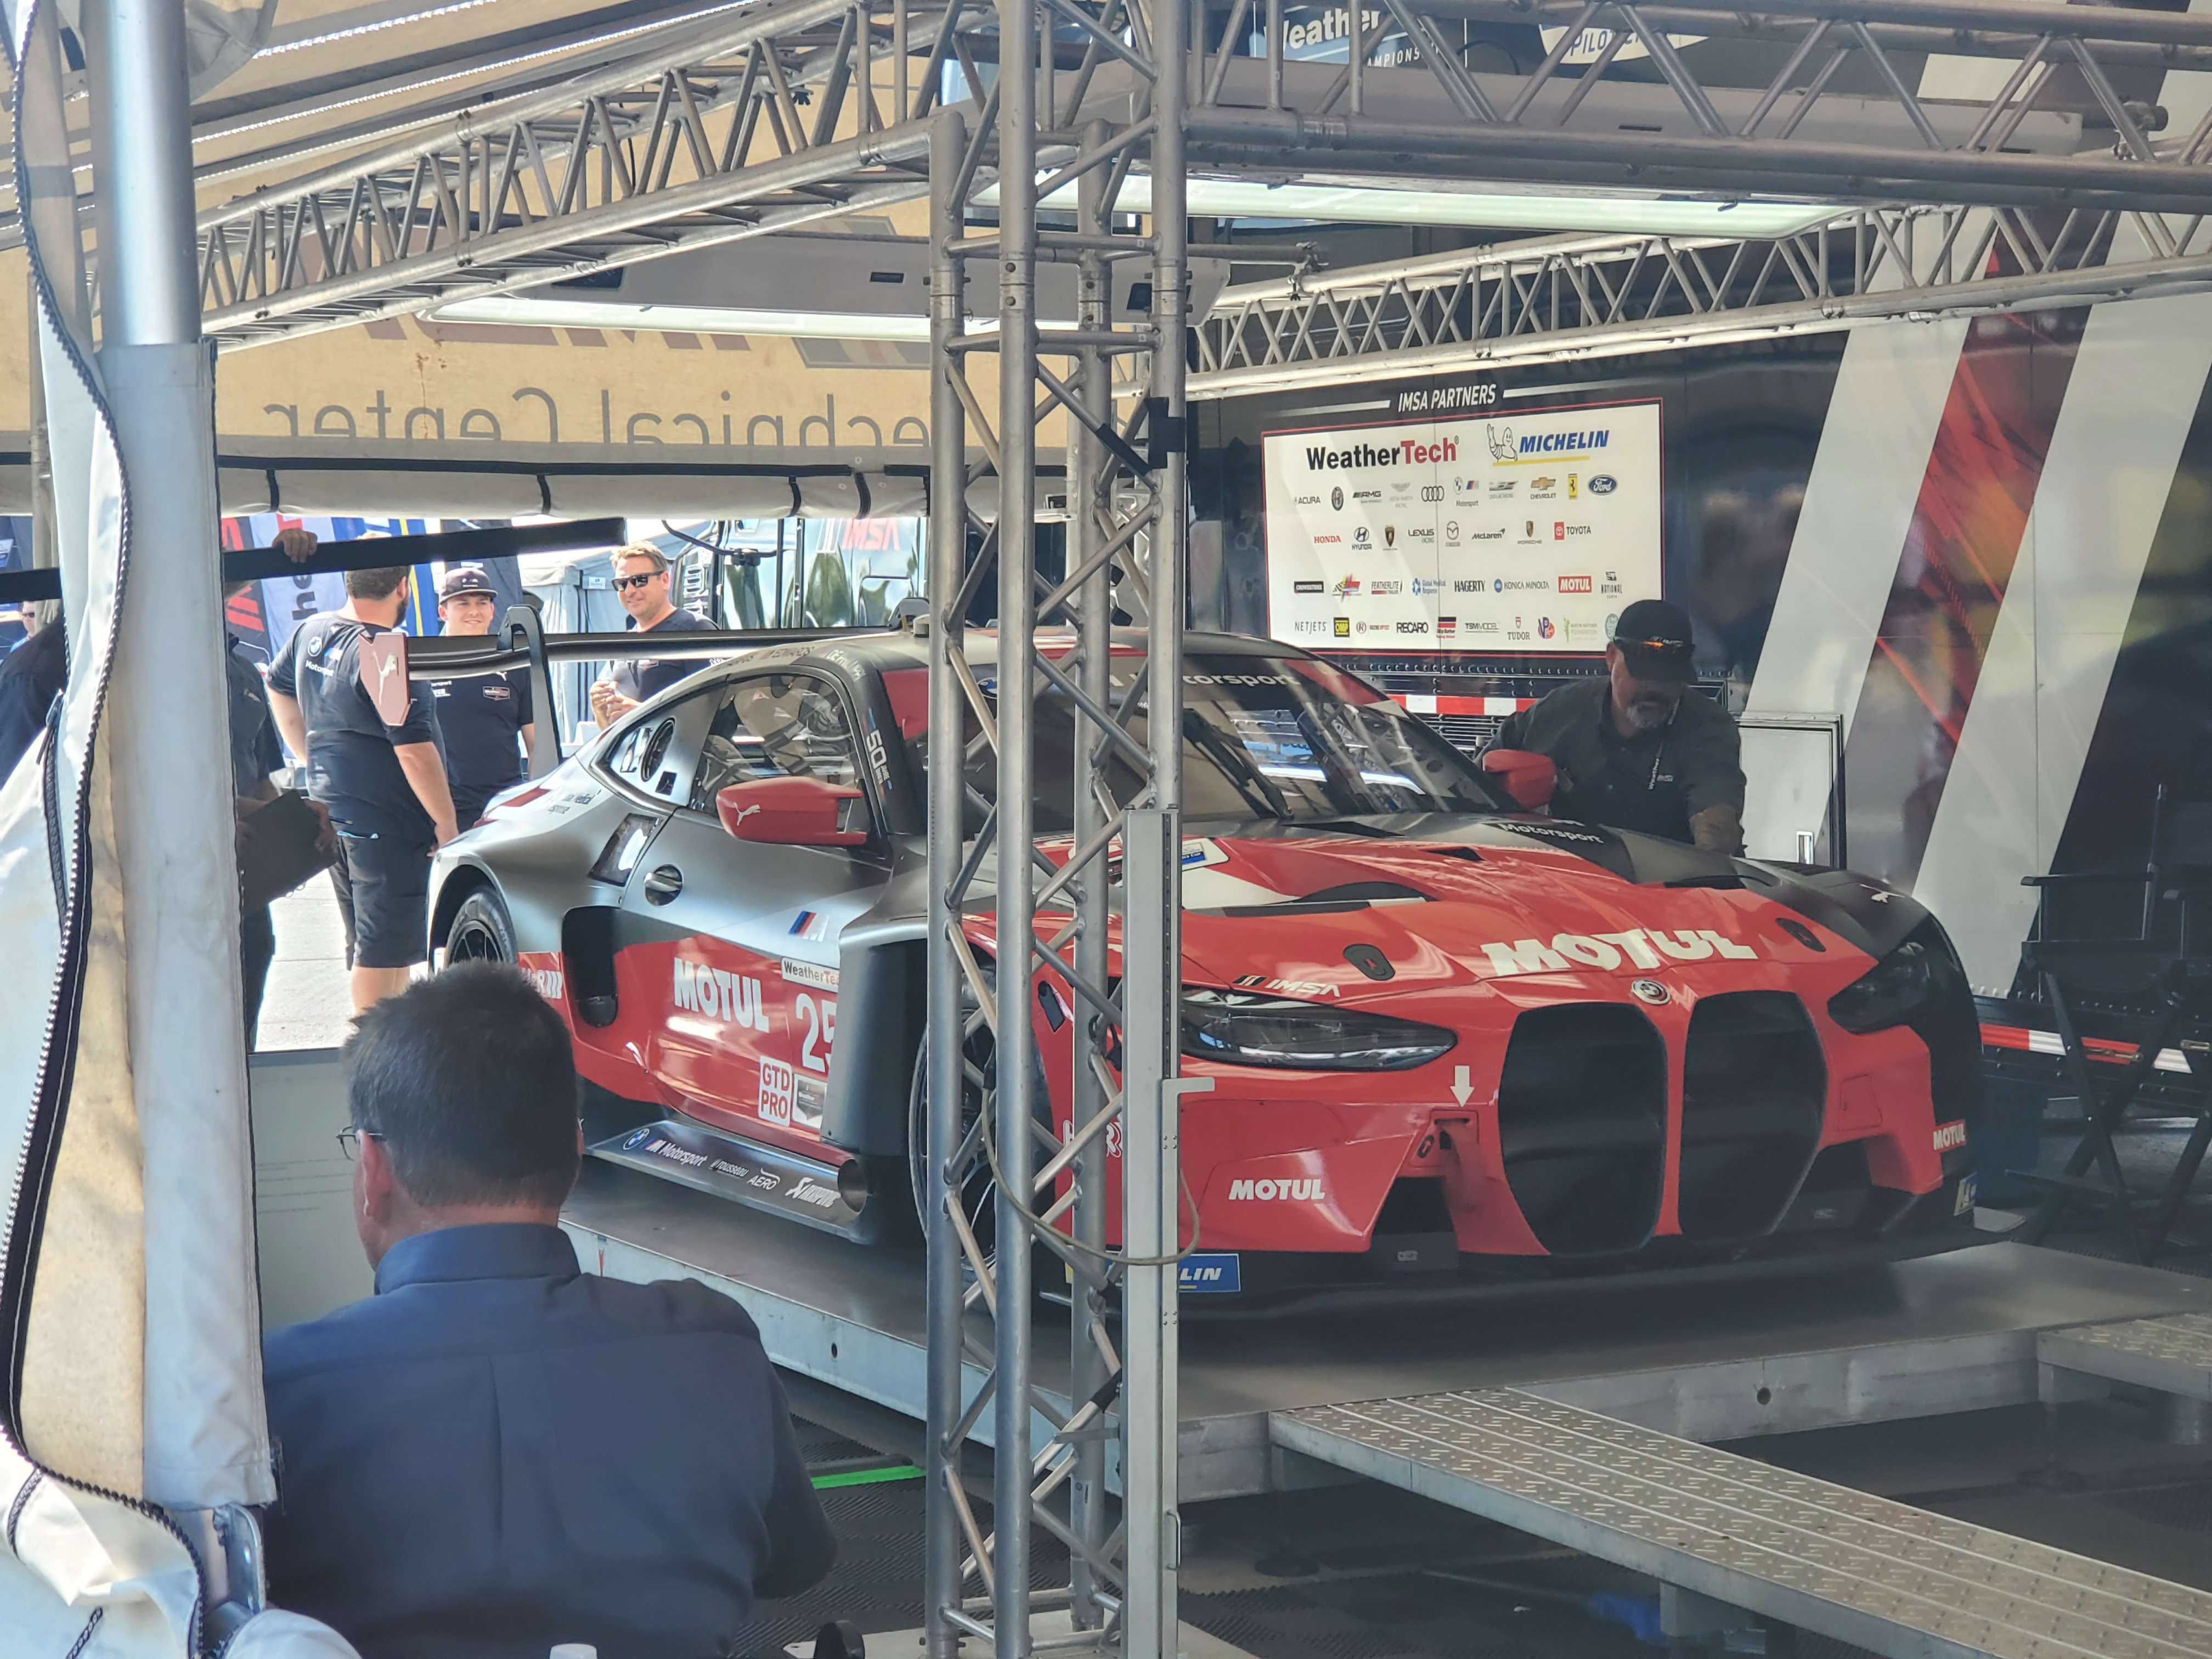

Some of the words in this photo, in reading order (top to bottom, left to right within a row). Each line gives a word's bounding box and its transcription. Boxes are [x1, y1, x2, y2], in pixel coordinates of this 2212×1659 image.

[1263, 8, 1381, 54] eather
[1570, 30, 1615, 56] PILO
[1398, 391, 1428, 413] IMSA
[1431, 384, 1497, 410] PARTNERS
[1520, 430, 1610, 453] MICHELIN
[1593, 478, 1612, 492] Ford
[1298, 496, 1321, 504] ACURA
[1408, 528, 1435, 537] LEXUS
[1566, 526, 1592, 535] TOYOTA
[1313, 535, 1341, 544] HONDA
[1454, 580, 1486, 592] HAGERTY
[1504, 581, 1525, 590] KONICA
[1526, 580, 1550, 590] MINOLTA
[1560, 578, 1590, 591] MOTUL
[1295, 621, 1327, 634] NETJETS
[1396, 622, 1429, 634] RECARO
[1506, 631, 1531, 641] TUDOR
[1182, 674, 1302, 687] torsport
[1497, 823, 1605, 844] Motorsport
[1480, 928, 1758, 977] MOTUL
[673, 957, 770, 1033] MOTUL
[1265, 979, 1341, 997] IMSA
[762, 1062, 791, 1092] GTD
[760, 1089, 788, 1120] PRO
[1933, 1123, 1966, 1150] MOTUL
[661, 1141, 708, 1167] Motorsport
[747, 1175, 778, 1190] AERO
[1228, 1178, 1327, 1201] MOTUL
